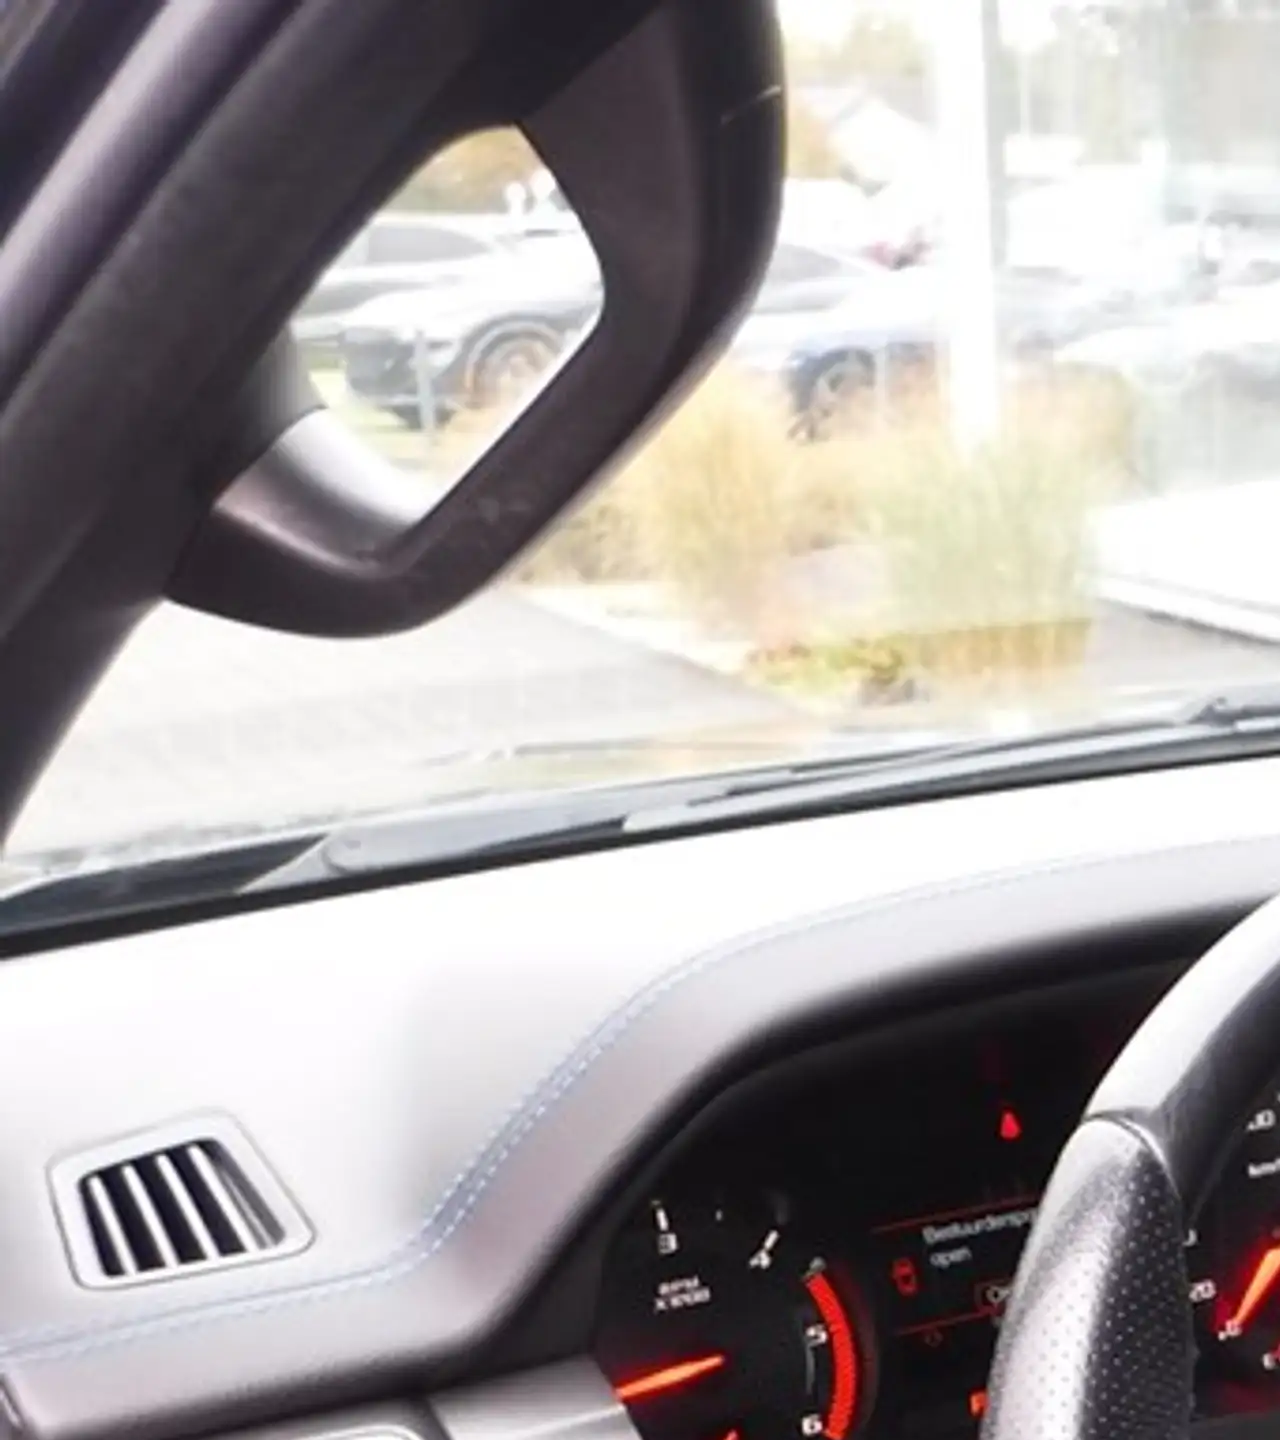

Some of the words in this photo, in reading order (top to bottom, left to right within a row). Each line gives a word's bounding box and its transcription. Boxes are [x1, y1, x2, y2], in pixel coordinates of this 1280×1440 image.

[749, 1249, 772, 1270] 4
[930, 1247, 972, 1268] open
[1189, 1279, 1216, 1302] 20
[805, 1324, 828, 1346] 5
[801, 1414, 823, 1437] 6
